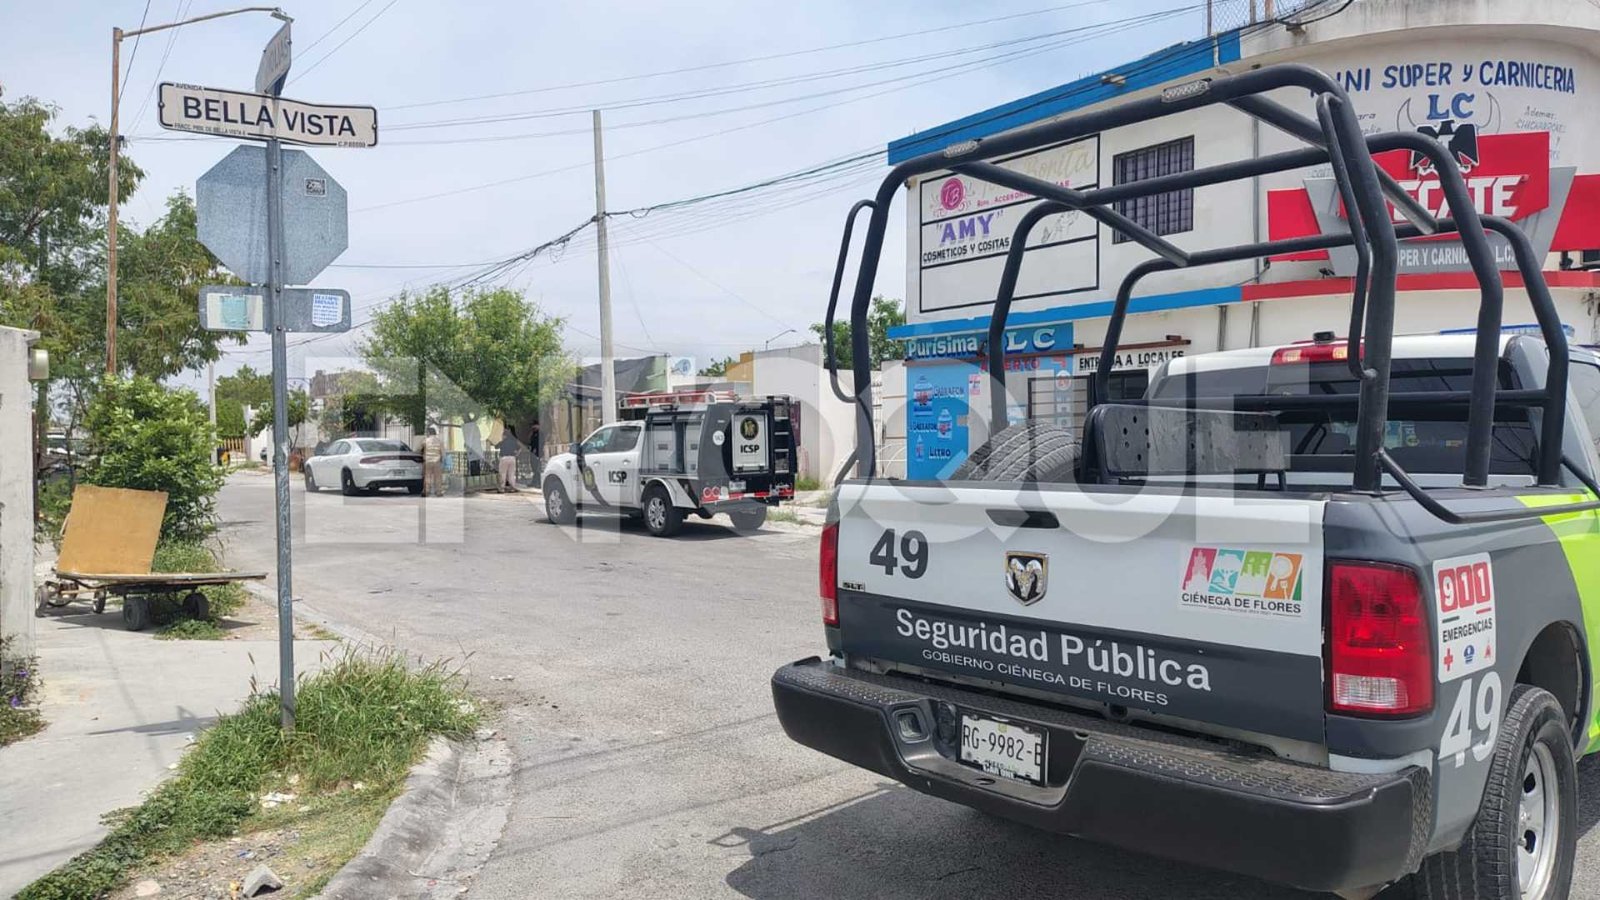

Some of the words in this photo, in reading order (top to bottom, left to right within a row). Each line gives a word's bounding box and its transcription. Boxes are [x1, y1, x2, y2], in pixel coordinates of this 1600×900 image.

[1382, 62, 1452, 88] SUPER
[1480, 61, 1575, 94] CARNICERIA
[183, 96, 274, 128] BELLA
[283, 108, 356, 137] VISTA
[1427, 93, 1475, 120] LC
[1393, 175, 1521, 221] ECTE
[923, 245, 968, 263] COSMETICOS
[970, 243, 976, 254] Y
[978, 237, 1010, 252] COSITAS
[1397, 249, 1419, 267] PER
[1422, 248, 1429, 265] Y
[1431, 246, 1470, 265] CARNIC
[981, 357, 1041, 371] AERTO
[1079, 354, 1122, 369] ENTRA
[1125, 353, 1133, 366] A
[740, 444, 760, 453] ICSP
[608, 470, 628, 484] ICSP
[869, 528, 929, 579] 49
[1441, 566, 1487, 608] 911
[1181, 592, 1231, 607] CIÉNEGA
[1234, 597, 1250, 608] DE
[1254, 600, 1301, 614] FLORES
[1442, 617, 1493, 643] EMERGENCIAS
[896, 608, 1049, 662] Seguridad
[1061, 633, 1211, 692] Pública
[922, 648, 993, 671] GOBIERNO
[997, 662, 1065, 687] CIÉNEGA
[1069, 675, 1091, 690] DE
[1097, 681, 1169, 706] FLORES
[1438, 671, 1502, 768] 49
